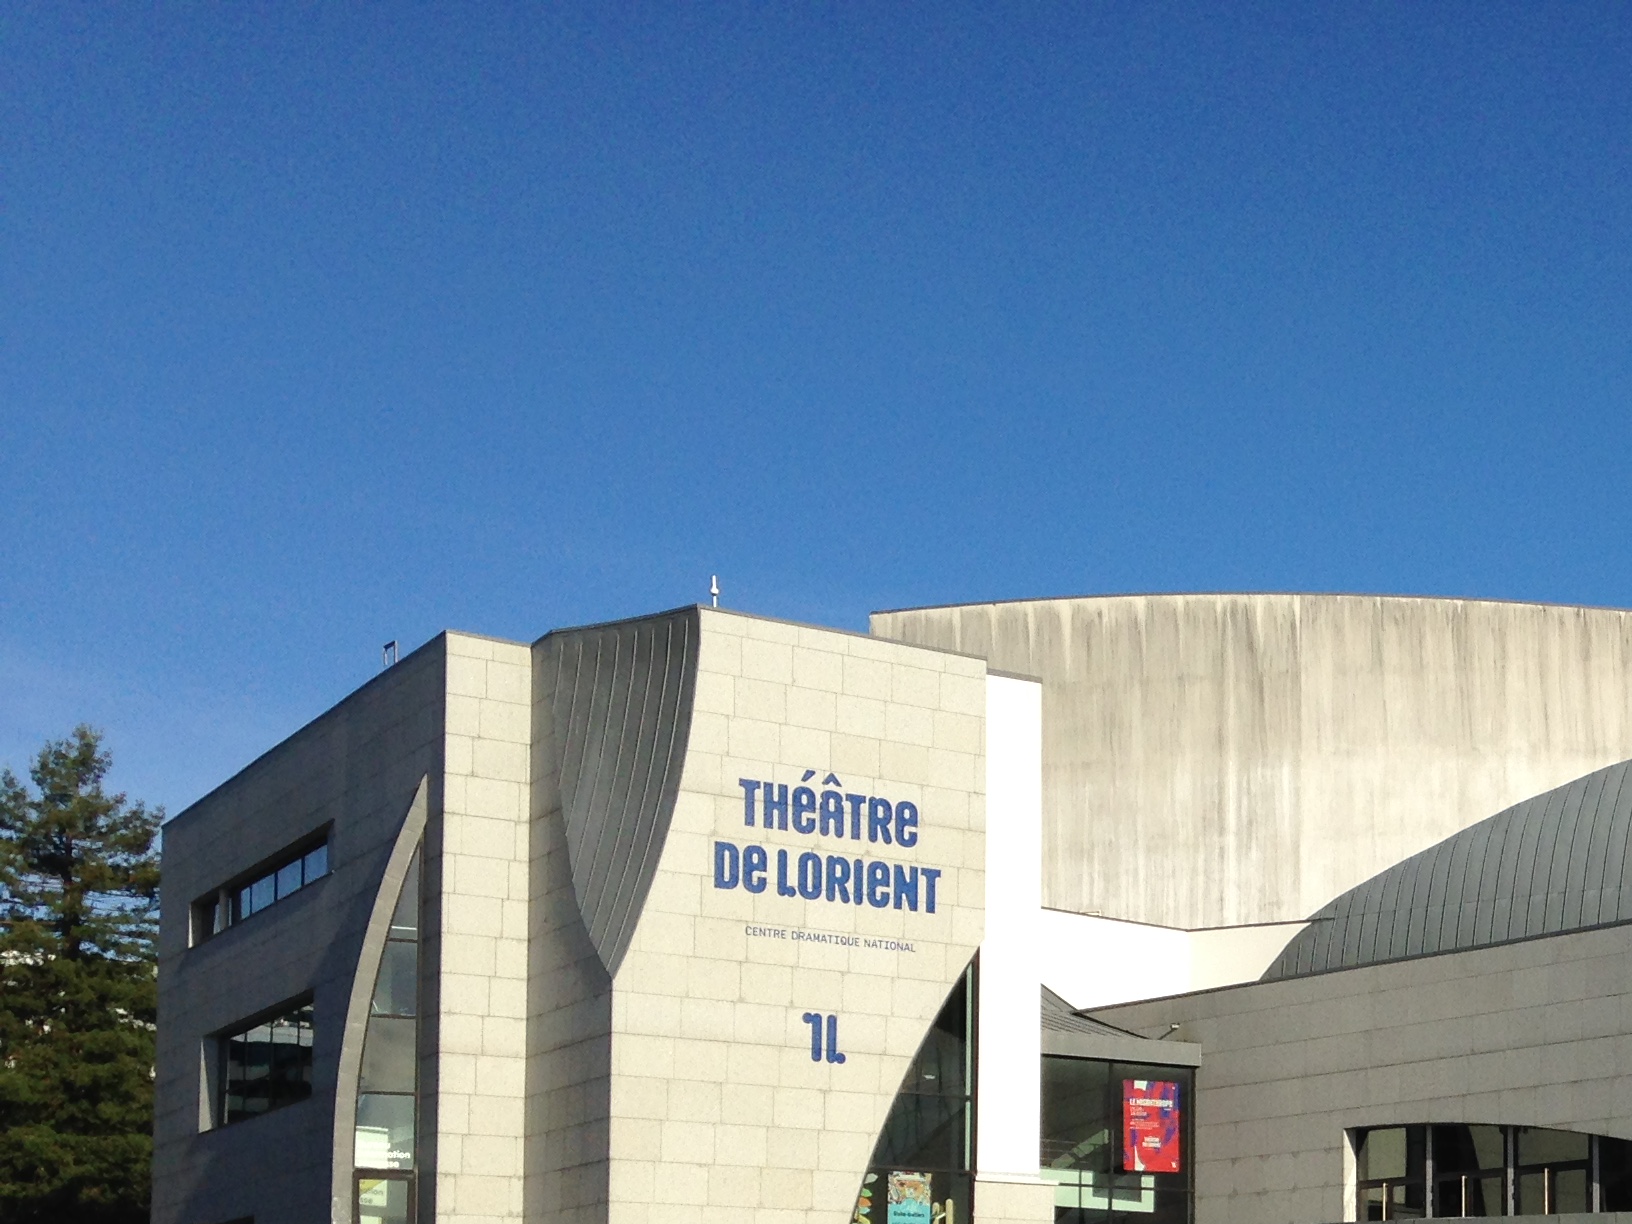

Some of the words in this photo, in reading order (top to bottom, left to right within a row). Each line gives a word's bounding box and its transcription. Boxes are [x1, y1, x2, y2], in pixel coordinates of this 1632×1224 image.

[745, 926, 787, 940] CENTRE
[791, 931, 860, 947] DRAMATIQUE
[864, 938, 916, 953] NATIONAL
